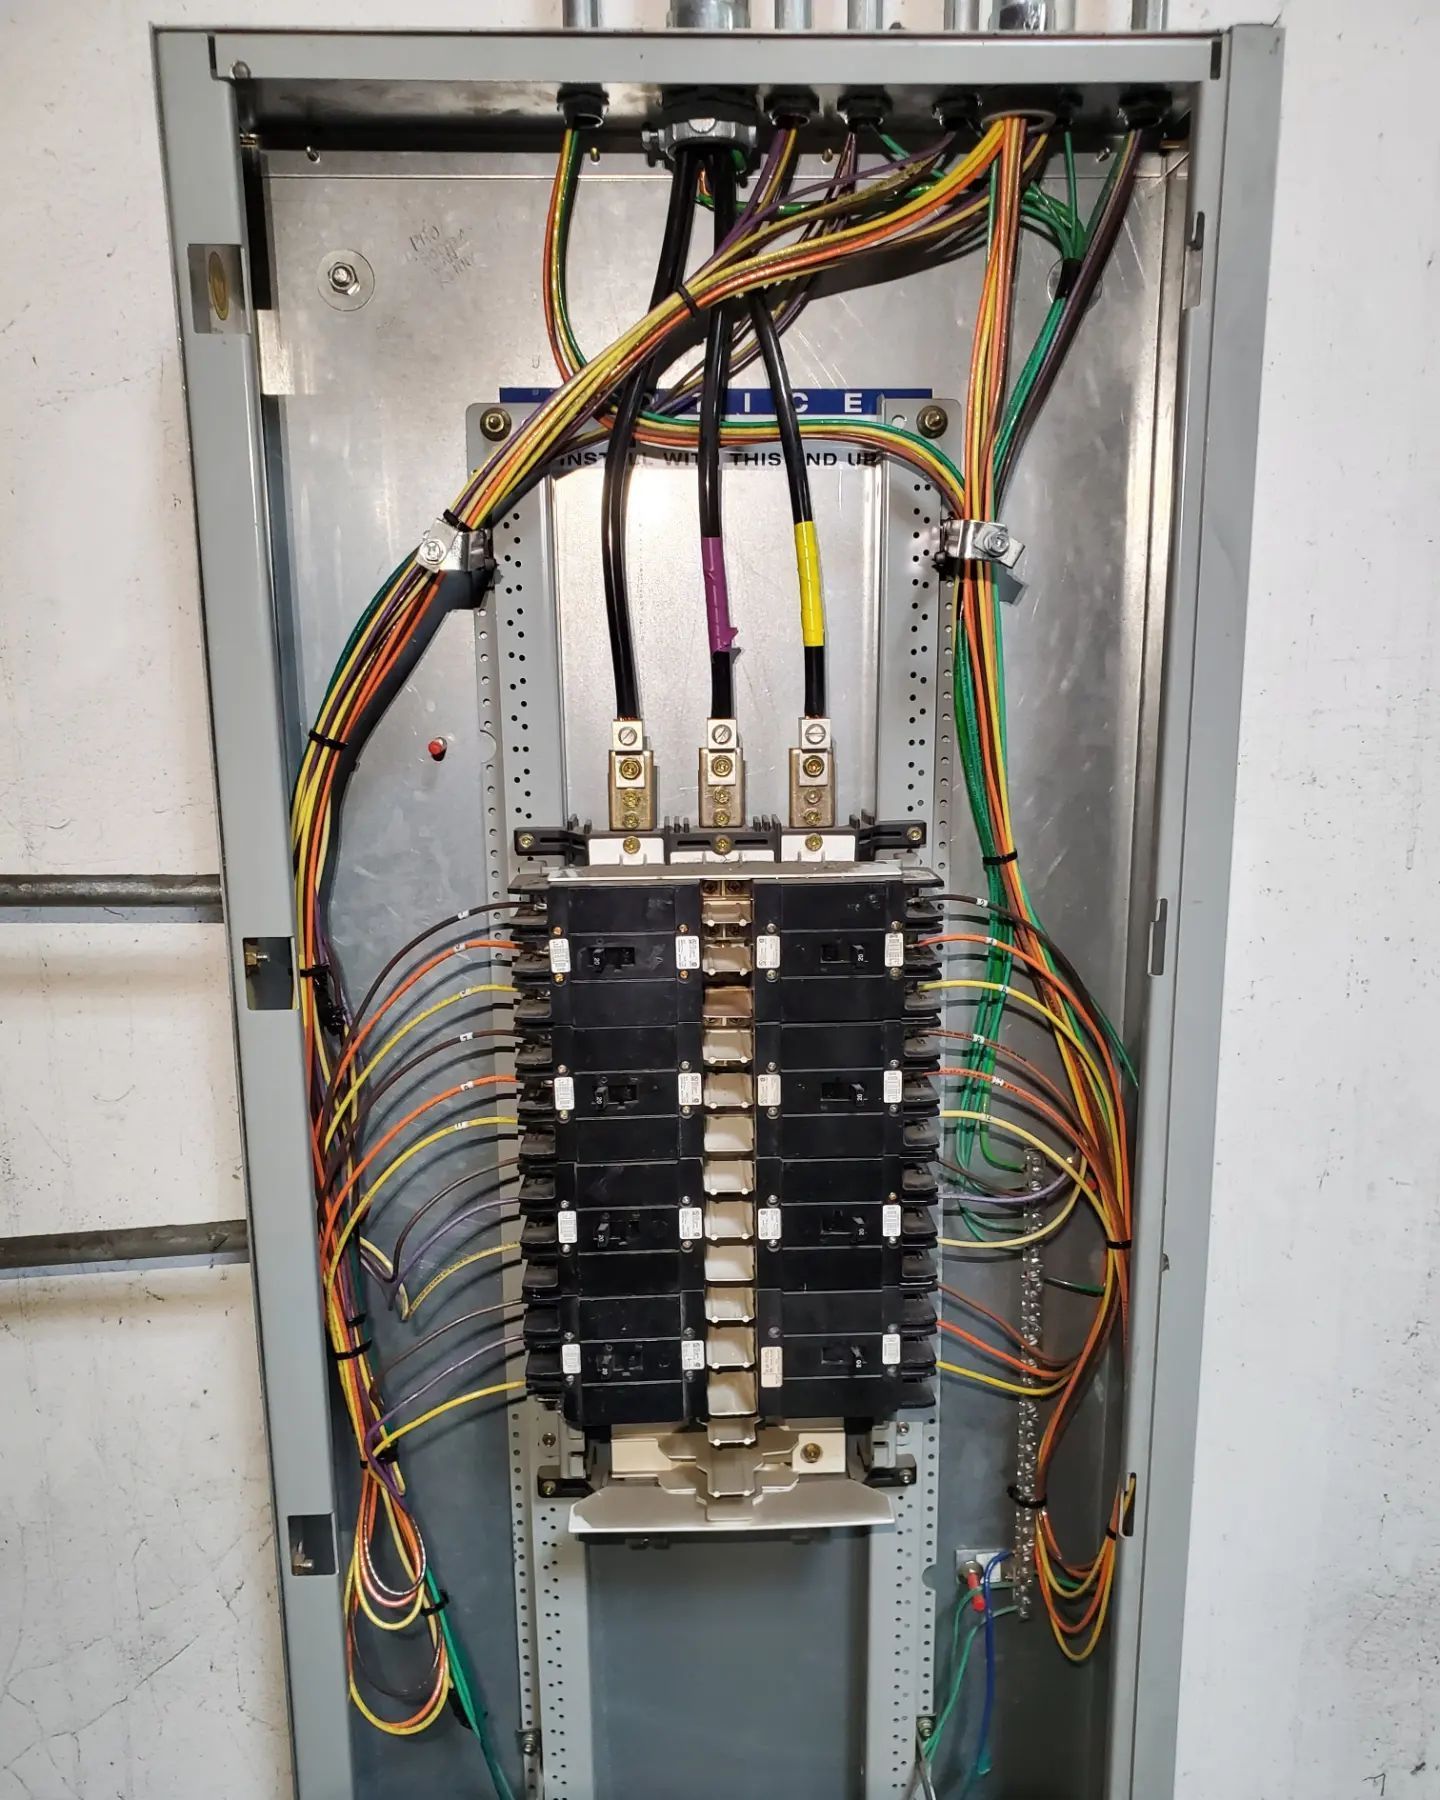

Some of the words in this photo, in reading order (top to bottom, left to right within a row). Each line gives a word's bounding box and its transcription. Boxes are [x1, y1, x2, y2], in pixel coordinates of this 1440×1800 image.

[663, 452, 700, 467] WIT
[729, 452, 782, 467] THIS
[805, 452, 838, 467] ND
[593, 957, 601, 966] 20
[857, 953, 864, 962] 20
[596, 1096, 603, 1105] 20
[856, 1093, 863, 1101] 20
